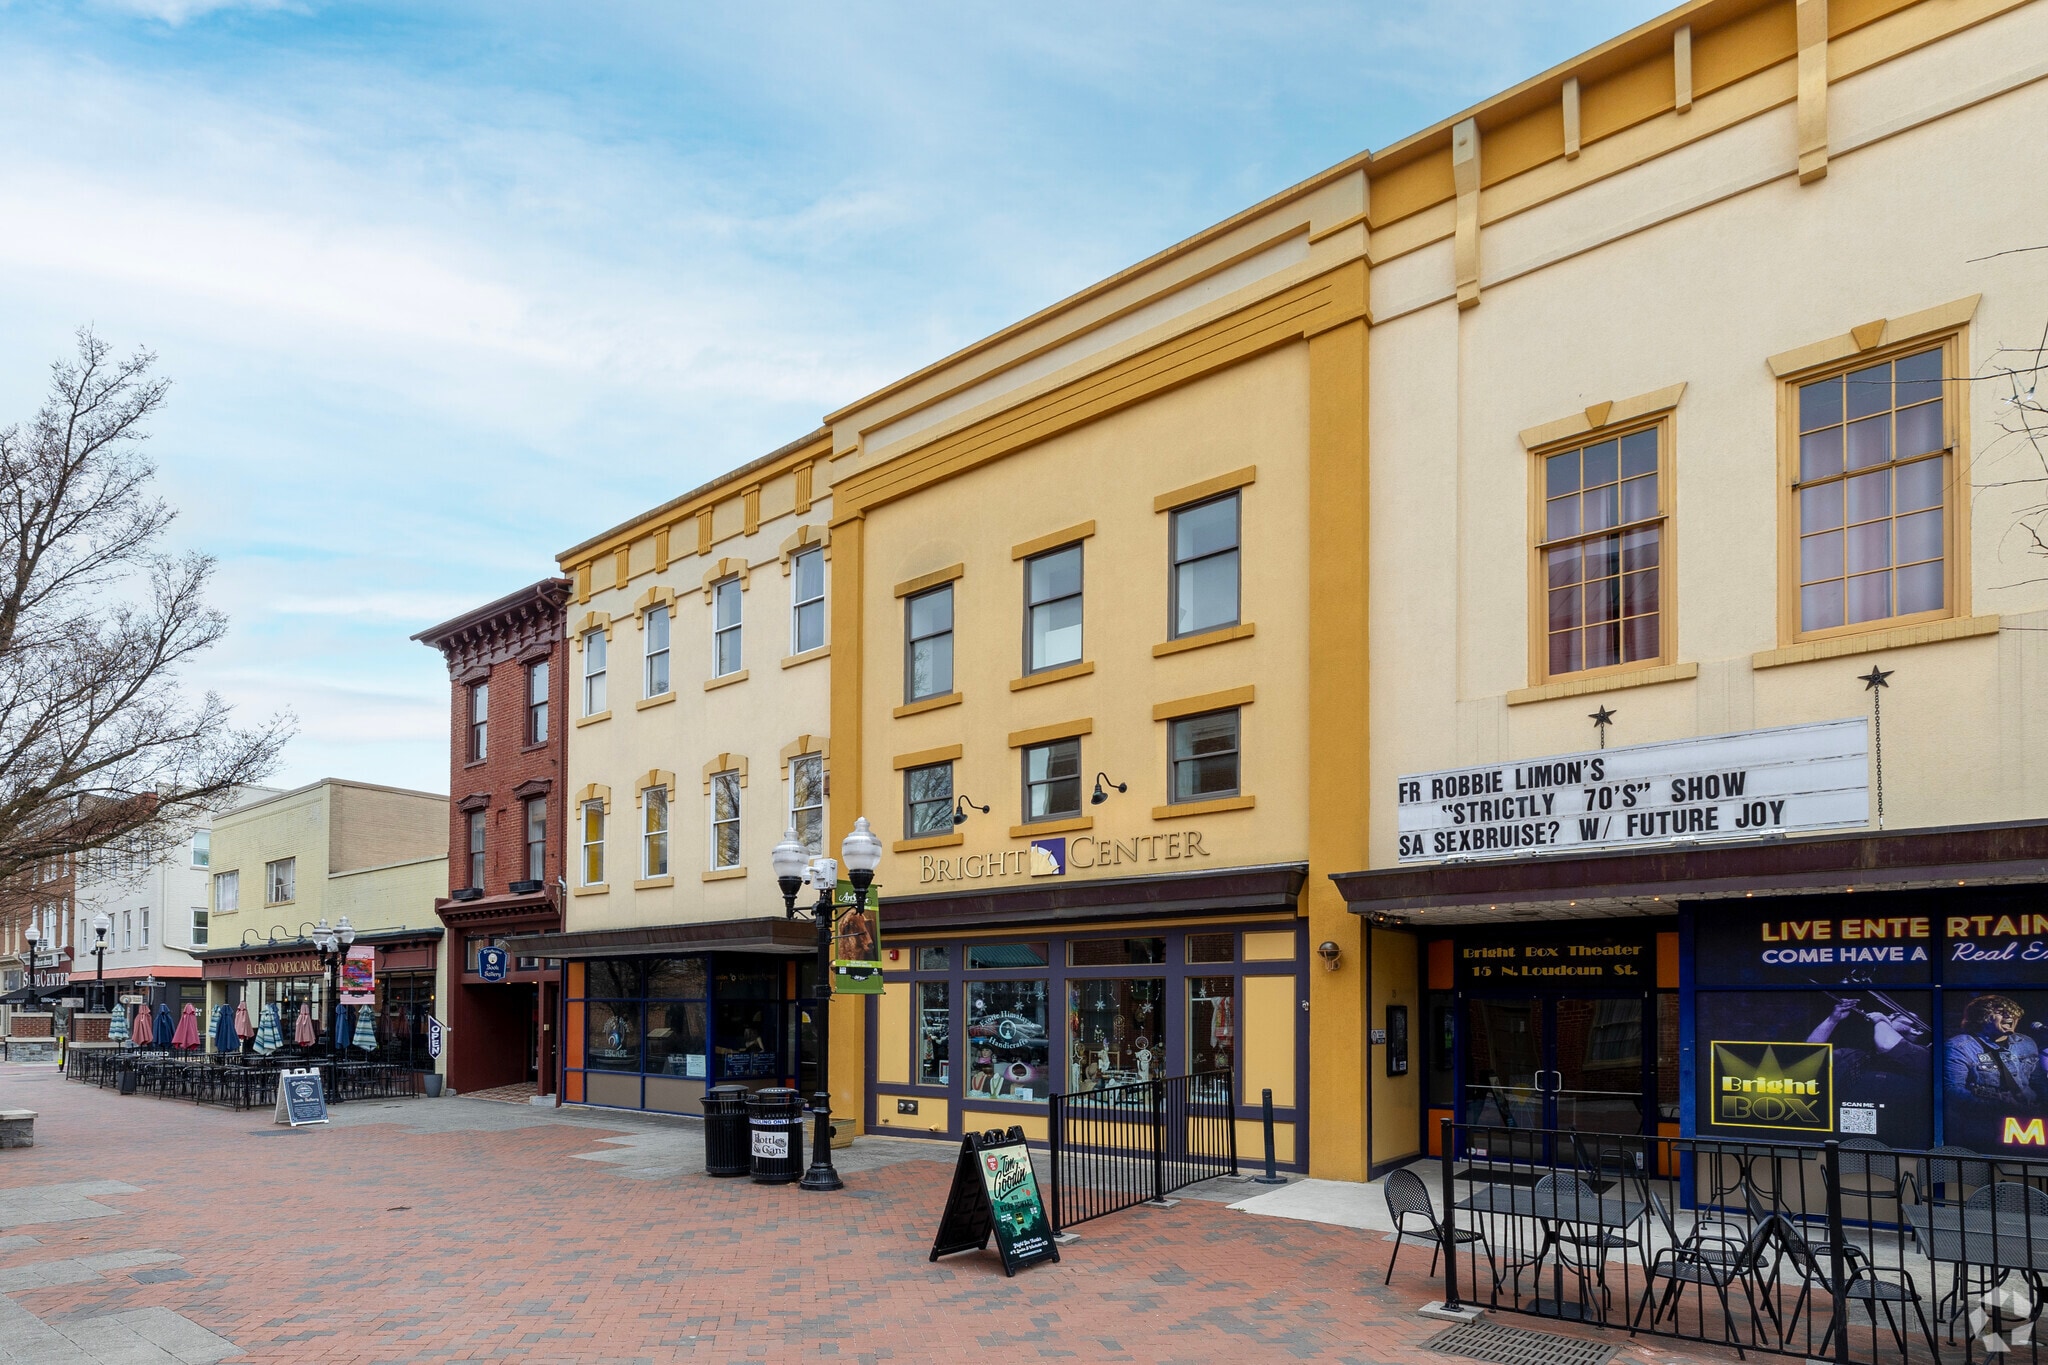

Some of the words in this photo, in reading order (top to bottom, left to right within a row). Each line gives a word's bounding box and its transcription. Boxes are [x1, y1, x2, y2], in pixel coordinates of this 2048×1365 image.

[1399, 781, 1421, 804] FR
[1432, 771, 1503, 800] ROBBIE
[1515, 758, 1604, 790] LIMON'S
[1441, 792, 1555, 825] "STRICTLY
[1583, 782, 1650, 811] 70'S"
[1671, 771, 1746, 803] SHOW
[1399, 834, 1424, 857] SA
[1434, 821, 1560, 853] SEXBRUISE?
[1579, 816, 1612, 841] W/
[1627, 806, 1719, 837] FUTURE
[1735, 800, 1785, 828] JOY
[919, 849, 1026, 884] BRIGHT
[1068, 830, 1210, 869] CENTER
[1762, 920, 1832, 942] LIVE
[1463, 947, 1516, 958] Bright
[1525, 946, 1559, 957] Box
[1567, 945, 1643, 956] Theater
[1762, 948, 1833, 964] COME
[1840, 946, 1904, 962] HAVE
[1911, 946, 1928, 961] A
[1951, 941, 2018, 961] Real
[246, 964, 253, 975] EL
[254, 962, 279, 975] CENTRO
[280, 959, 310, 973] MEXICAN
[1472, 966, 1492, 977] 15
[1501, 966, 1519, 976] N.
[1521, 965, 1603, 976] Loudoun
[1613, 964, 1639, 976] St.
[979, 1013, 1000, 1028] Exotic
[1000, 1010, 1036, 1028] Himalayan
[430, 1025, 441, 1055] OPEN
[988, 1036, 1030, 1049] Handicrafts
[1721, 1076, 1820, 1097] Bright
[1721, 1096, 1821, 1123] BOX
[1001, 1155, 1015, 1177] Tim
